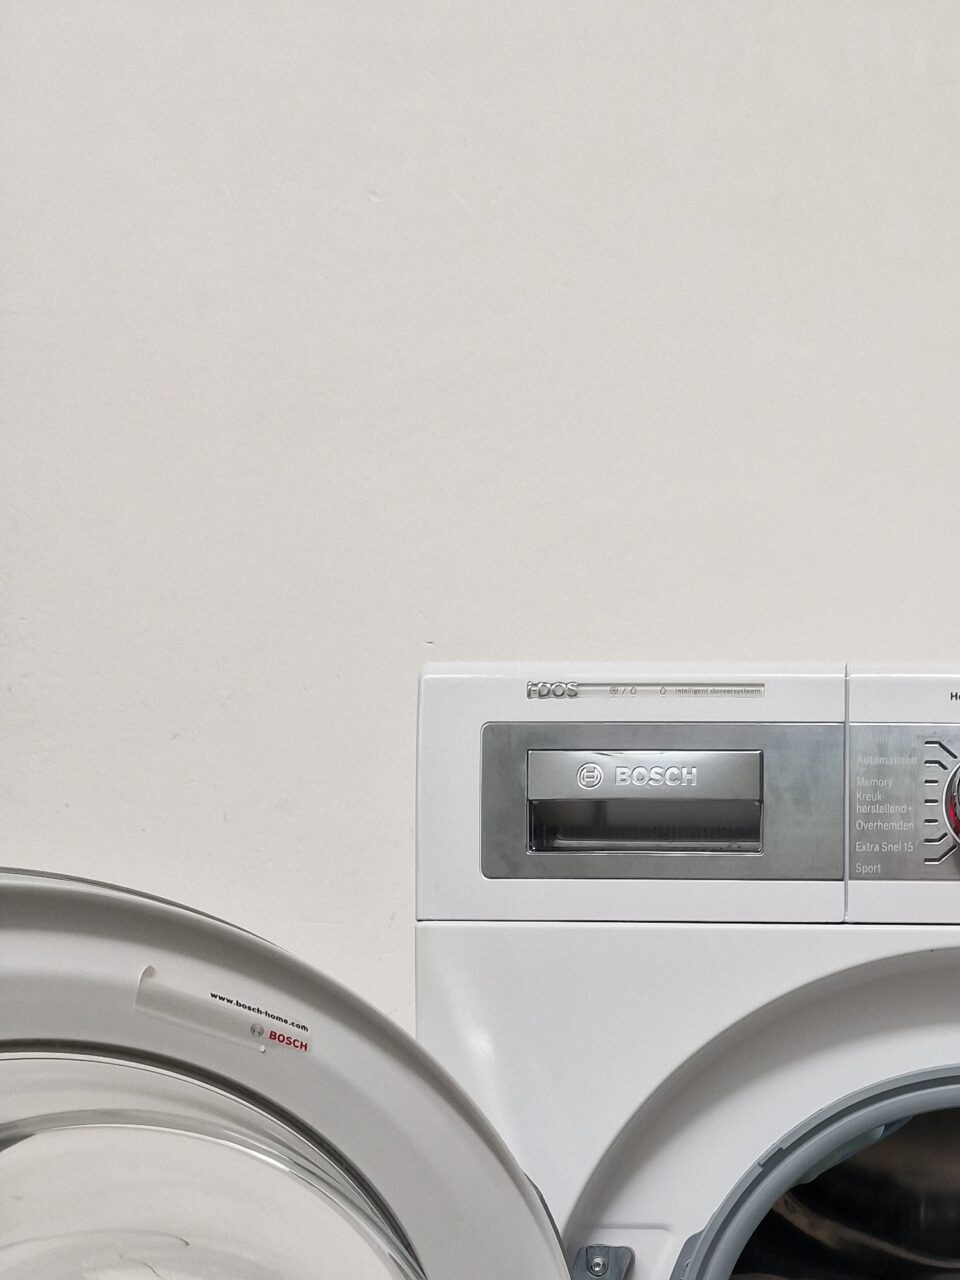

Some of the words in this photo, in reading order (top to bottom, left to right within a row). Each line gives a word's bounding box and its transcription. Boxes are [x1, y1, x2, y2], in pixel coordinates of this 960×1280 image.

[615, 766, 698, 786] BOSCH
[855, 819, 915, 831] Overhemden
[855, 842, 880, 852] Extra
[881, 842, 902, 852] Snel
[855, 863, 882, 875] Sport
[210, 992, 309, 1032] www.bosch-home.com
[269, 1030, 308, 1051] BOSCH
